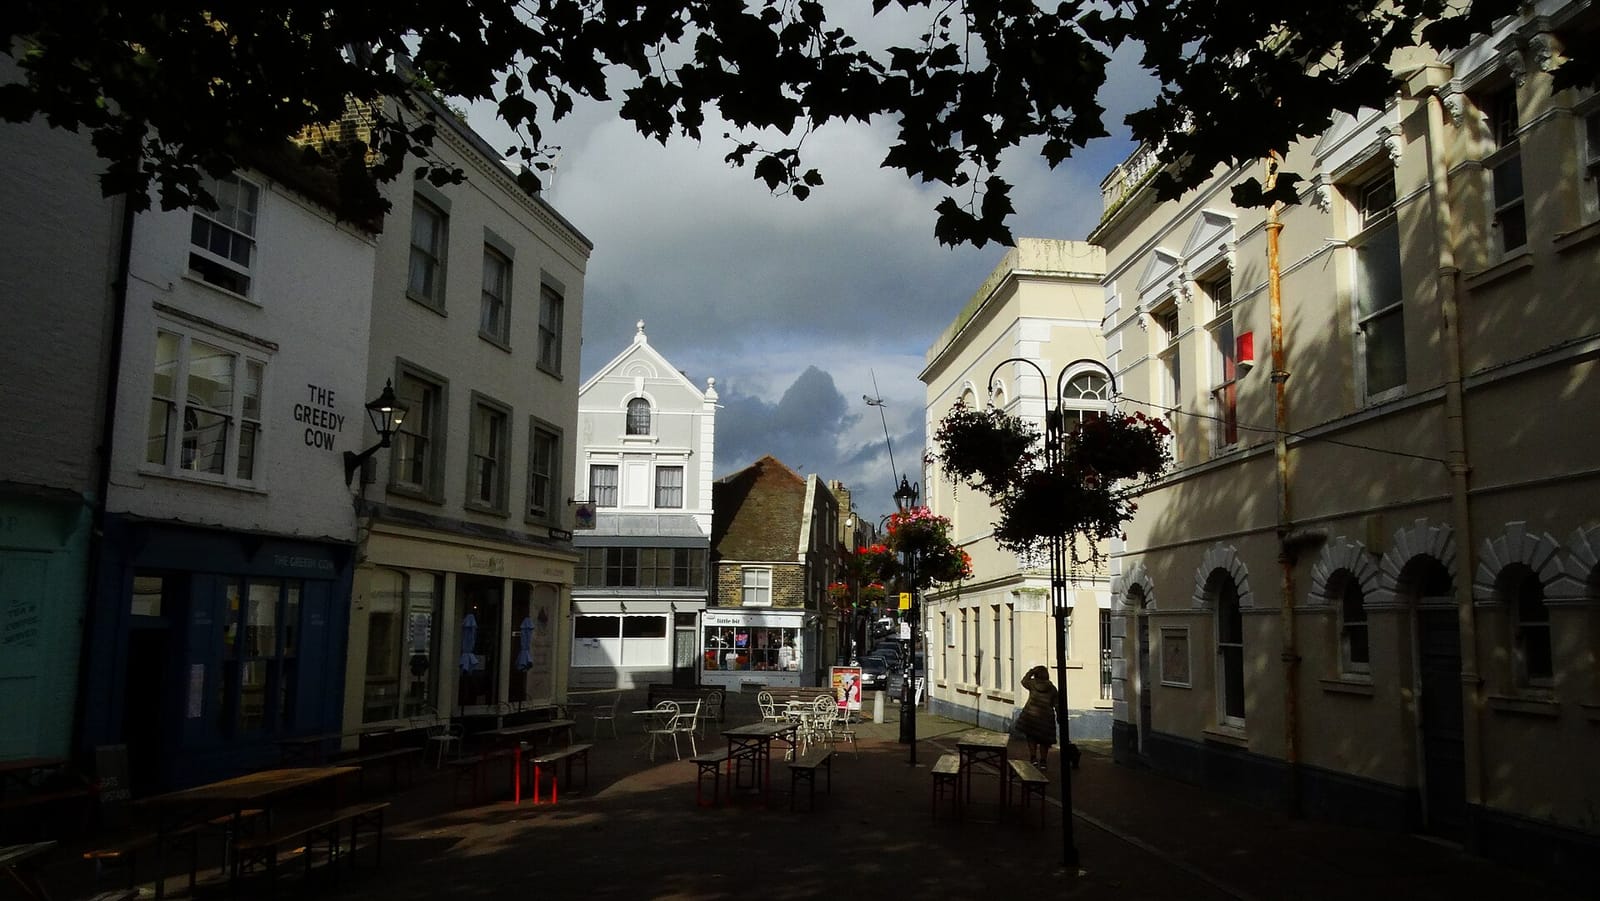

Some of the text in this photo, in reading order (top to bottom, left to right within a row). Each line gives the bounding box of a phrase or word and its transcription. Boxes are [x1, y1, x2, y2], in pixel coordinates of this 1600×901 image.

[308, 384, 335, 408] THE
[294, 404, 345, 432] GREEDY
[305, 428, 335, 450] COW
